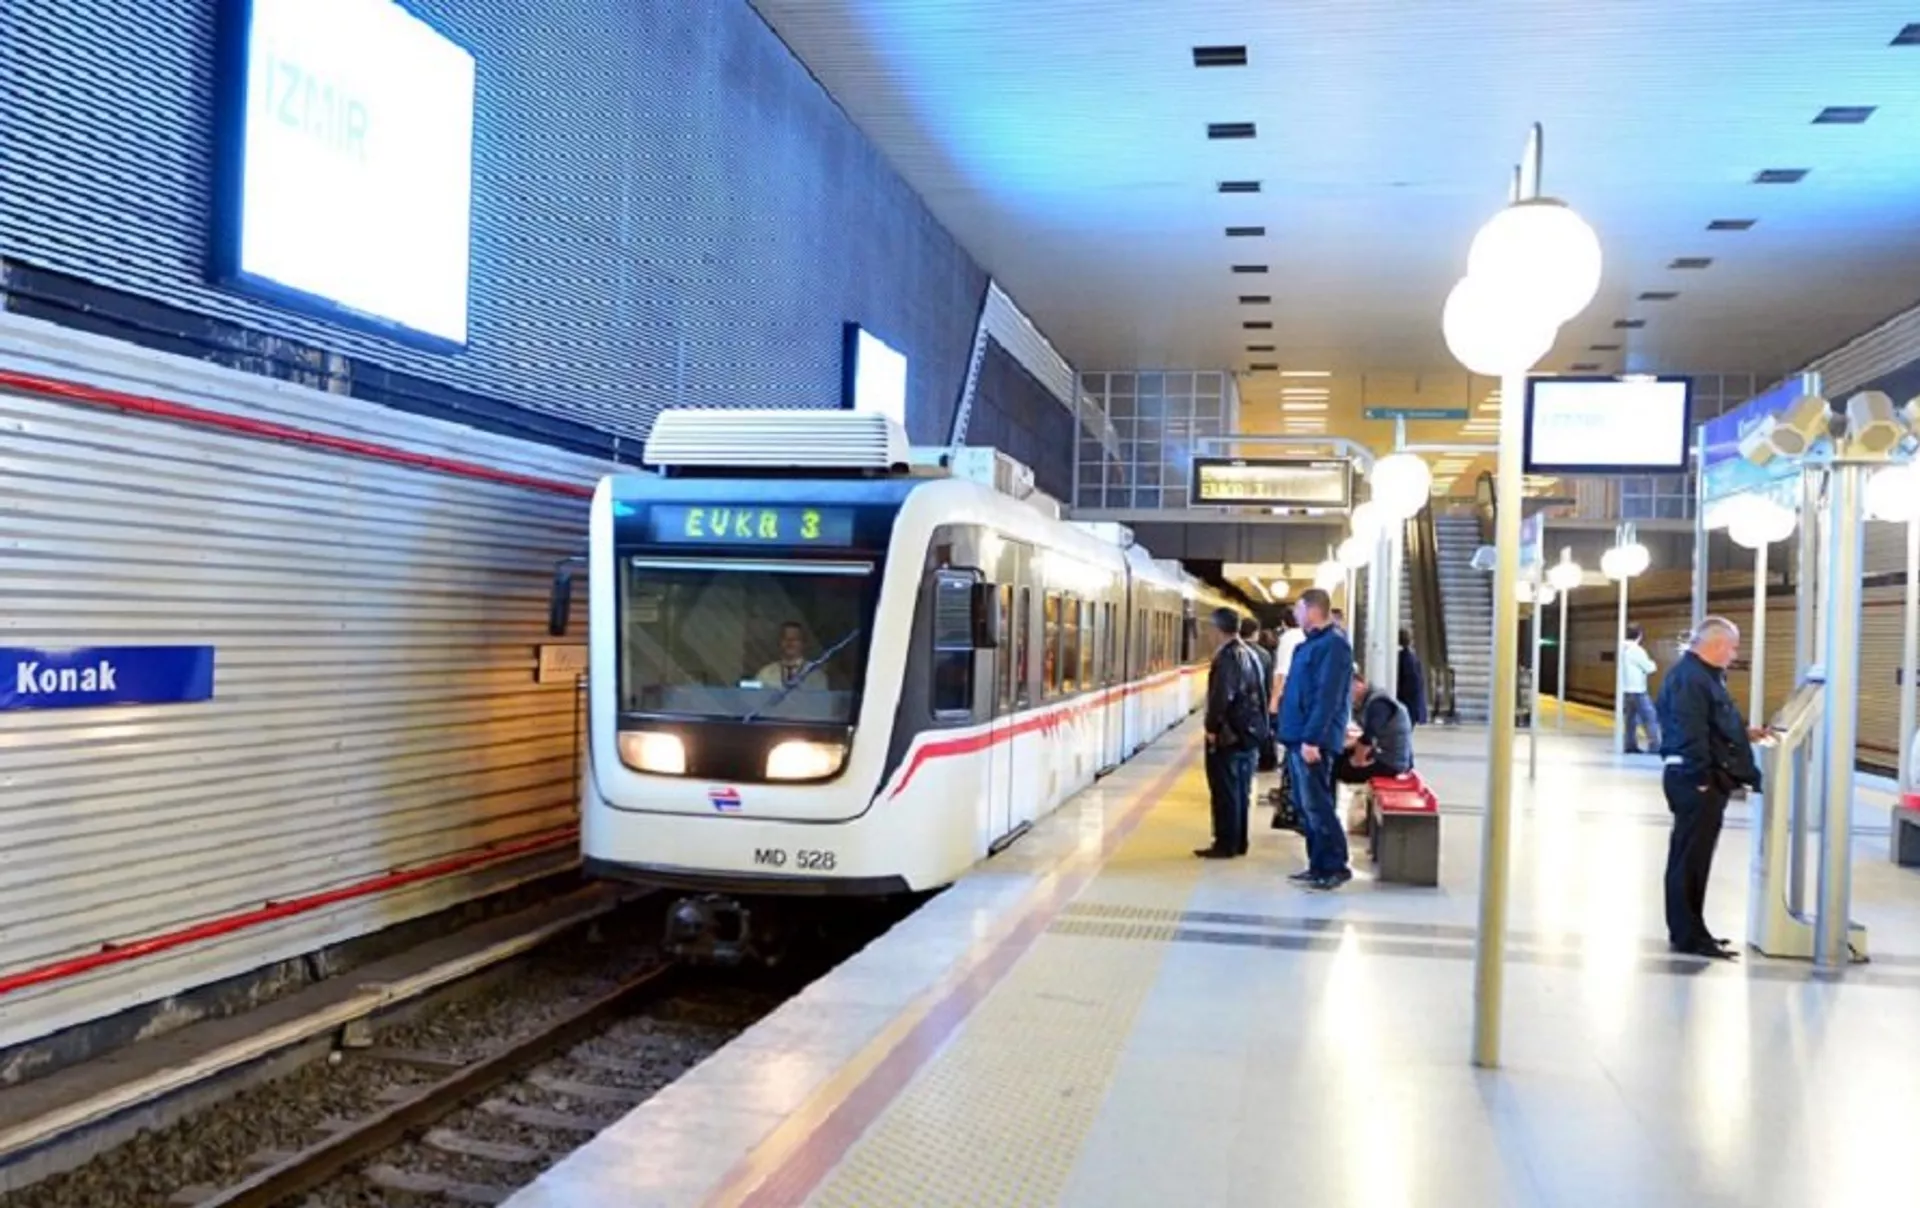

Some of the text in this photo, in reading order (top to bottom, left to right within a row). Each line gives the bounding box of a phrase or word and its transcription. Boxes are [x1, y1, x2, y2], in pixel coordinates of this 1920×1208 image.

[801, 509, 820, 539] 3
[17, 660, 117, 694] Konak
[754, 848, 836, 870] MD 528
